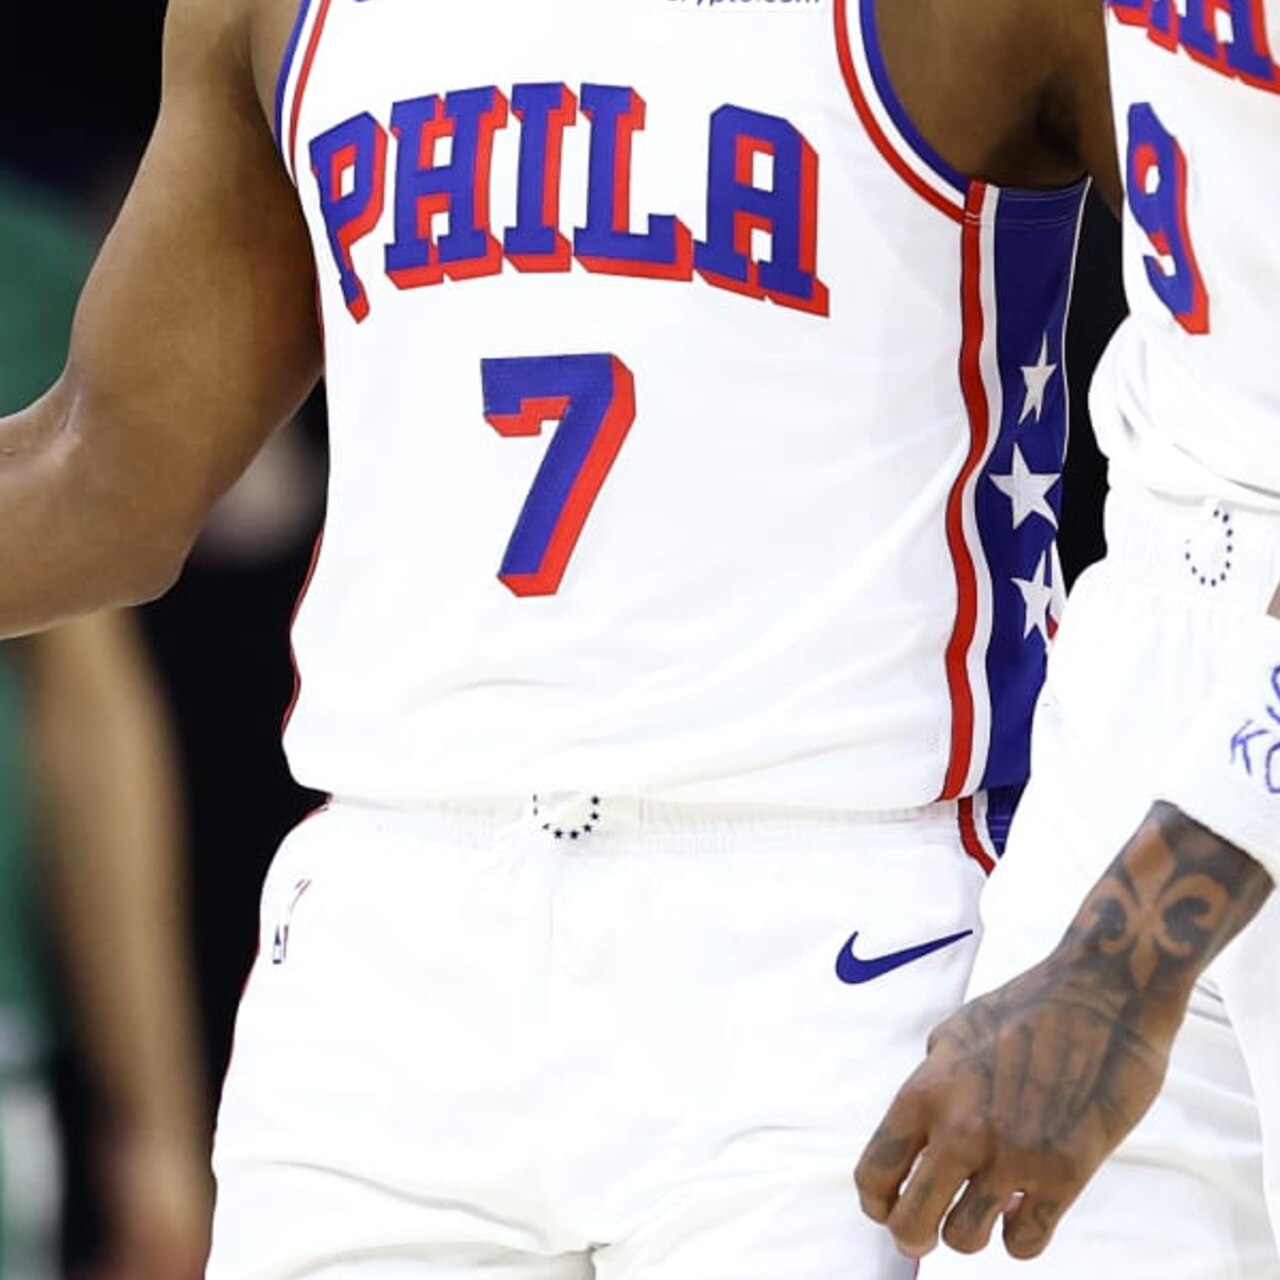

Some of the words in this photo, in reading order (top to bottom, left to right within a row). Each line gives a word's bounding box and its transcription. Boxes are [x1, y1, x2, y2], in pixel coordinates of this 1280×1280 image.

[308, 81, 831, 324] PHILA
[1126, 101, 1210, 335] 9
[480, 352, 637, 598] 7
